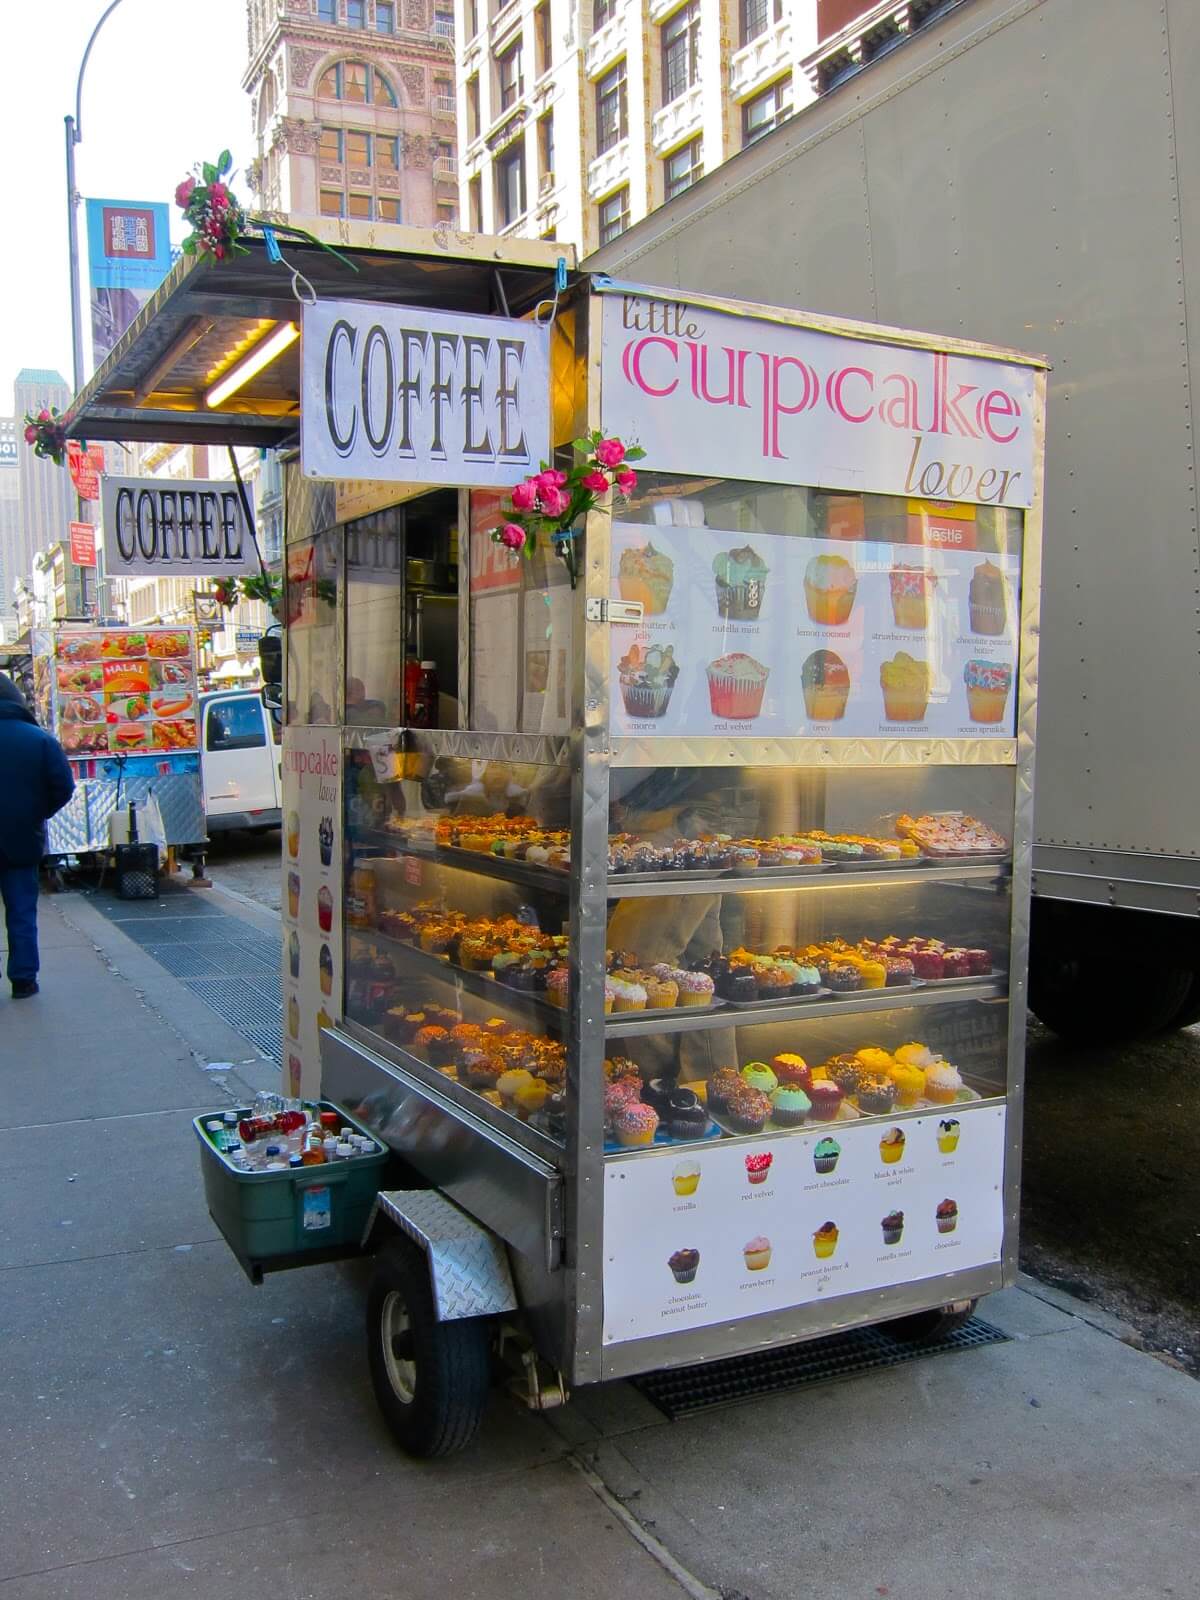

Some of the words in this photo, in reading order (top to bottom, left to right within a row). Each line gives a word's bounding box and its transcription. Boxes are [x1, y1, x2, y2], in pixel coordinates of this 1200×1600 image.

[622, 294, 705, 339] little
[325, 319, 530, 466] COFFEE
[622, 336, 1021, 460] cupcake
[904, 436, 1021, 502] lover
[115, 487, 245, 564] COFFEE
[711, 623, 739, 635] nutella
[741, 626, 760, 635] mint
[105, 663, 144, 675] HALAL
[714, 720, 728, 731] red
[284, 738, 337, 790] cupcake
[318, 775, 337, 802] lover
[741, 1192, 753, 1201] red
[753, 1189, 775, 1199] velvet
[672, 1202, 697, 1213] vanilla
[800, 1266, 823, 1279] peanut
[739, 1277, 776, 1290] strawberry
[667, 1292, 702, 1305] chocolate
[660, 1304, 687, 1318] peanut
[686, 1300, 709, 1313] butter
